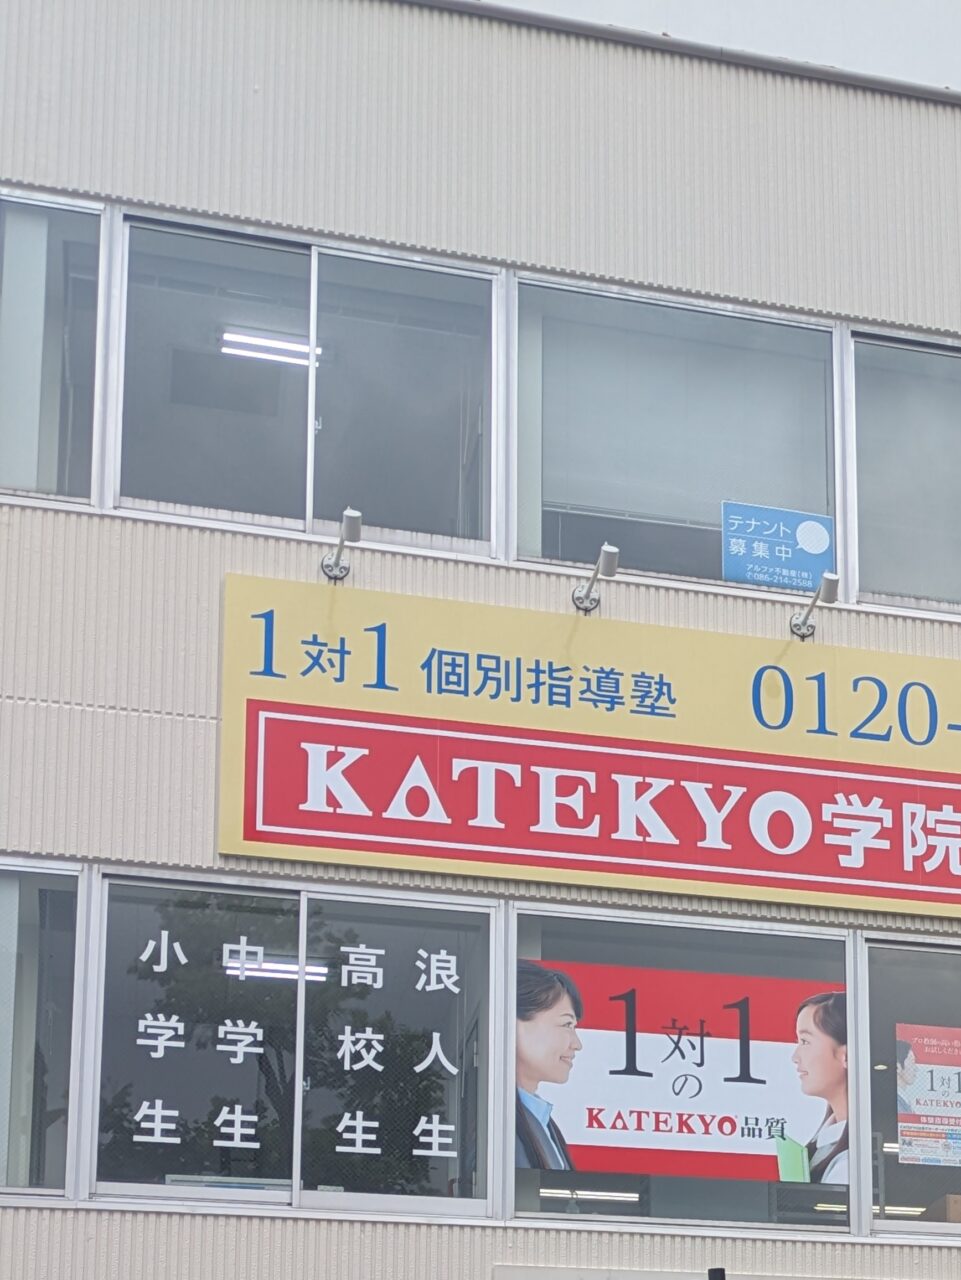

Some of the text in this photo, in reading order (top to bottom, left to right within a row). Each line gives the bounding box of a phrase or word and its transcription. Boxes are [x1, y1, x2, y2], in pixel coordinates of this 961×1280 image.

[728, 515, 791, 537] テナント
[728, 538, 792, 561] 募集中
[420, 647, 678, 719] 個別指導塾
[132, 930, 189, 1144] 小学生
[212, 936, 264, 1149] 中学生
[335, 944, 386, 1155] 高校生
[412, 948, 461, 1158] 浪人生
[608, 988, 767, 1085] 1対1
[585, 1107, 788, 1141] KATEKYO品質
[671, 1073, 703, 1099] の
